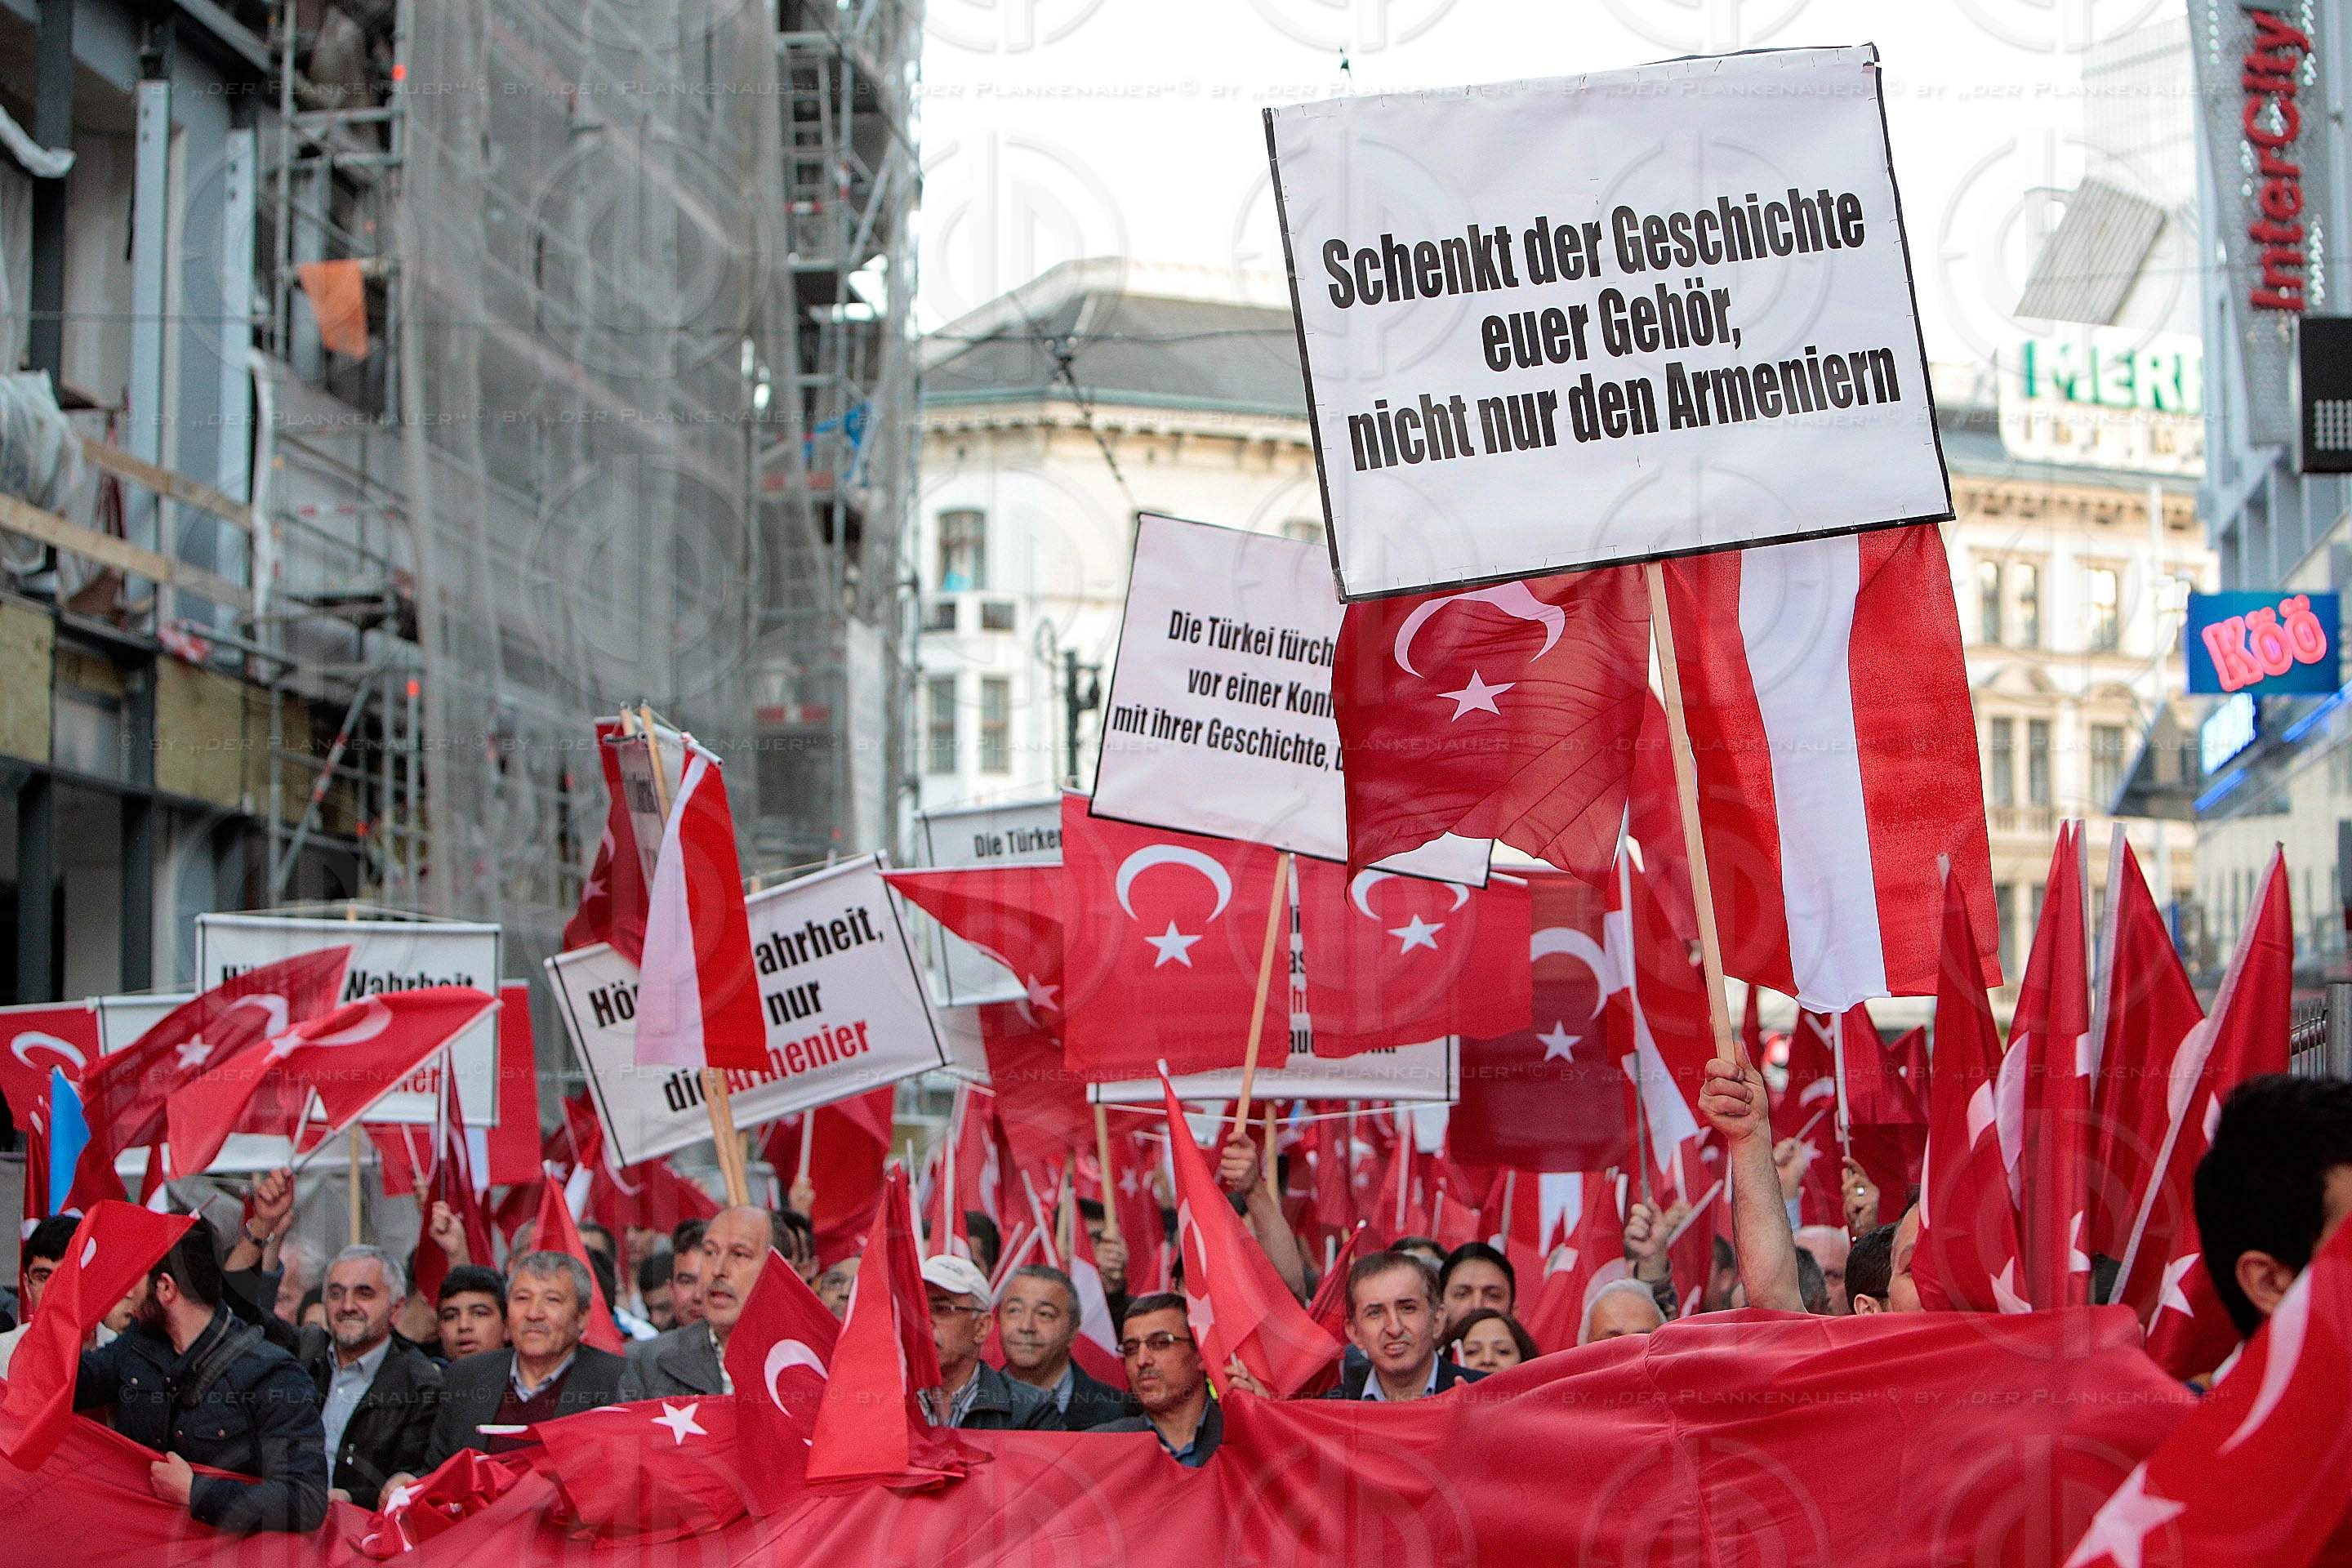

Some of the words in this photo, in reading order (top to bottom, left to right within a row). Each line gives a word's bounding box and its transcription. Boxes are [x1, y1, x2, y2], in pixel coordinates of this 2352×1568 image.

[2242, 7, 2311, 312] InterCity
[1322, 224, 1519, 309] Schenkt
[1524, 216, 1602, 285] der
[1611, 188, 1864, 274] Geschichte
[1481, 303, 1588, 372] euer
[1598, 277, 1741, 357] Gehör,
[1348, 394, 1475, 471] nicht
[1477, 389, 1557, 455] nur
[1569, 373, 1659, 443] den
[1666, 345, 1900, 430] Armeniern
[2024, 338, 2205, 415] MER
[1169, 610, 1202, 644] Die
[1209, 616, 1274, 657] Türkei
[1277, 629, 1334, 667] fürch
[2202, 595, 2327, 693] Köö
[1188, 668, 1222, 697] vor
[1226, 673, 1282, 709] einer
[1285, 682, 1334, 719] Kon
[1112, 703, 1147, 735] mit
[1151, 707, 1204, 745] ihrer
[1207, 717, 1329, 771] Geschichte,
[974, 834, 1003, 858] Die
[755, 906, 885, 976] ahrheit,
[767, 981, 822, 1025] nur
